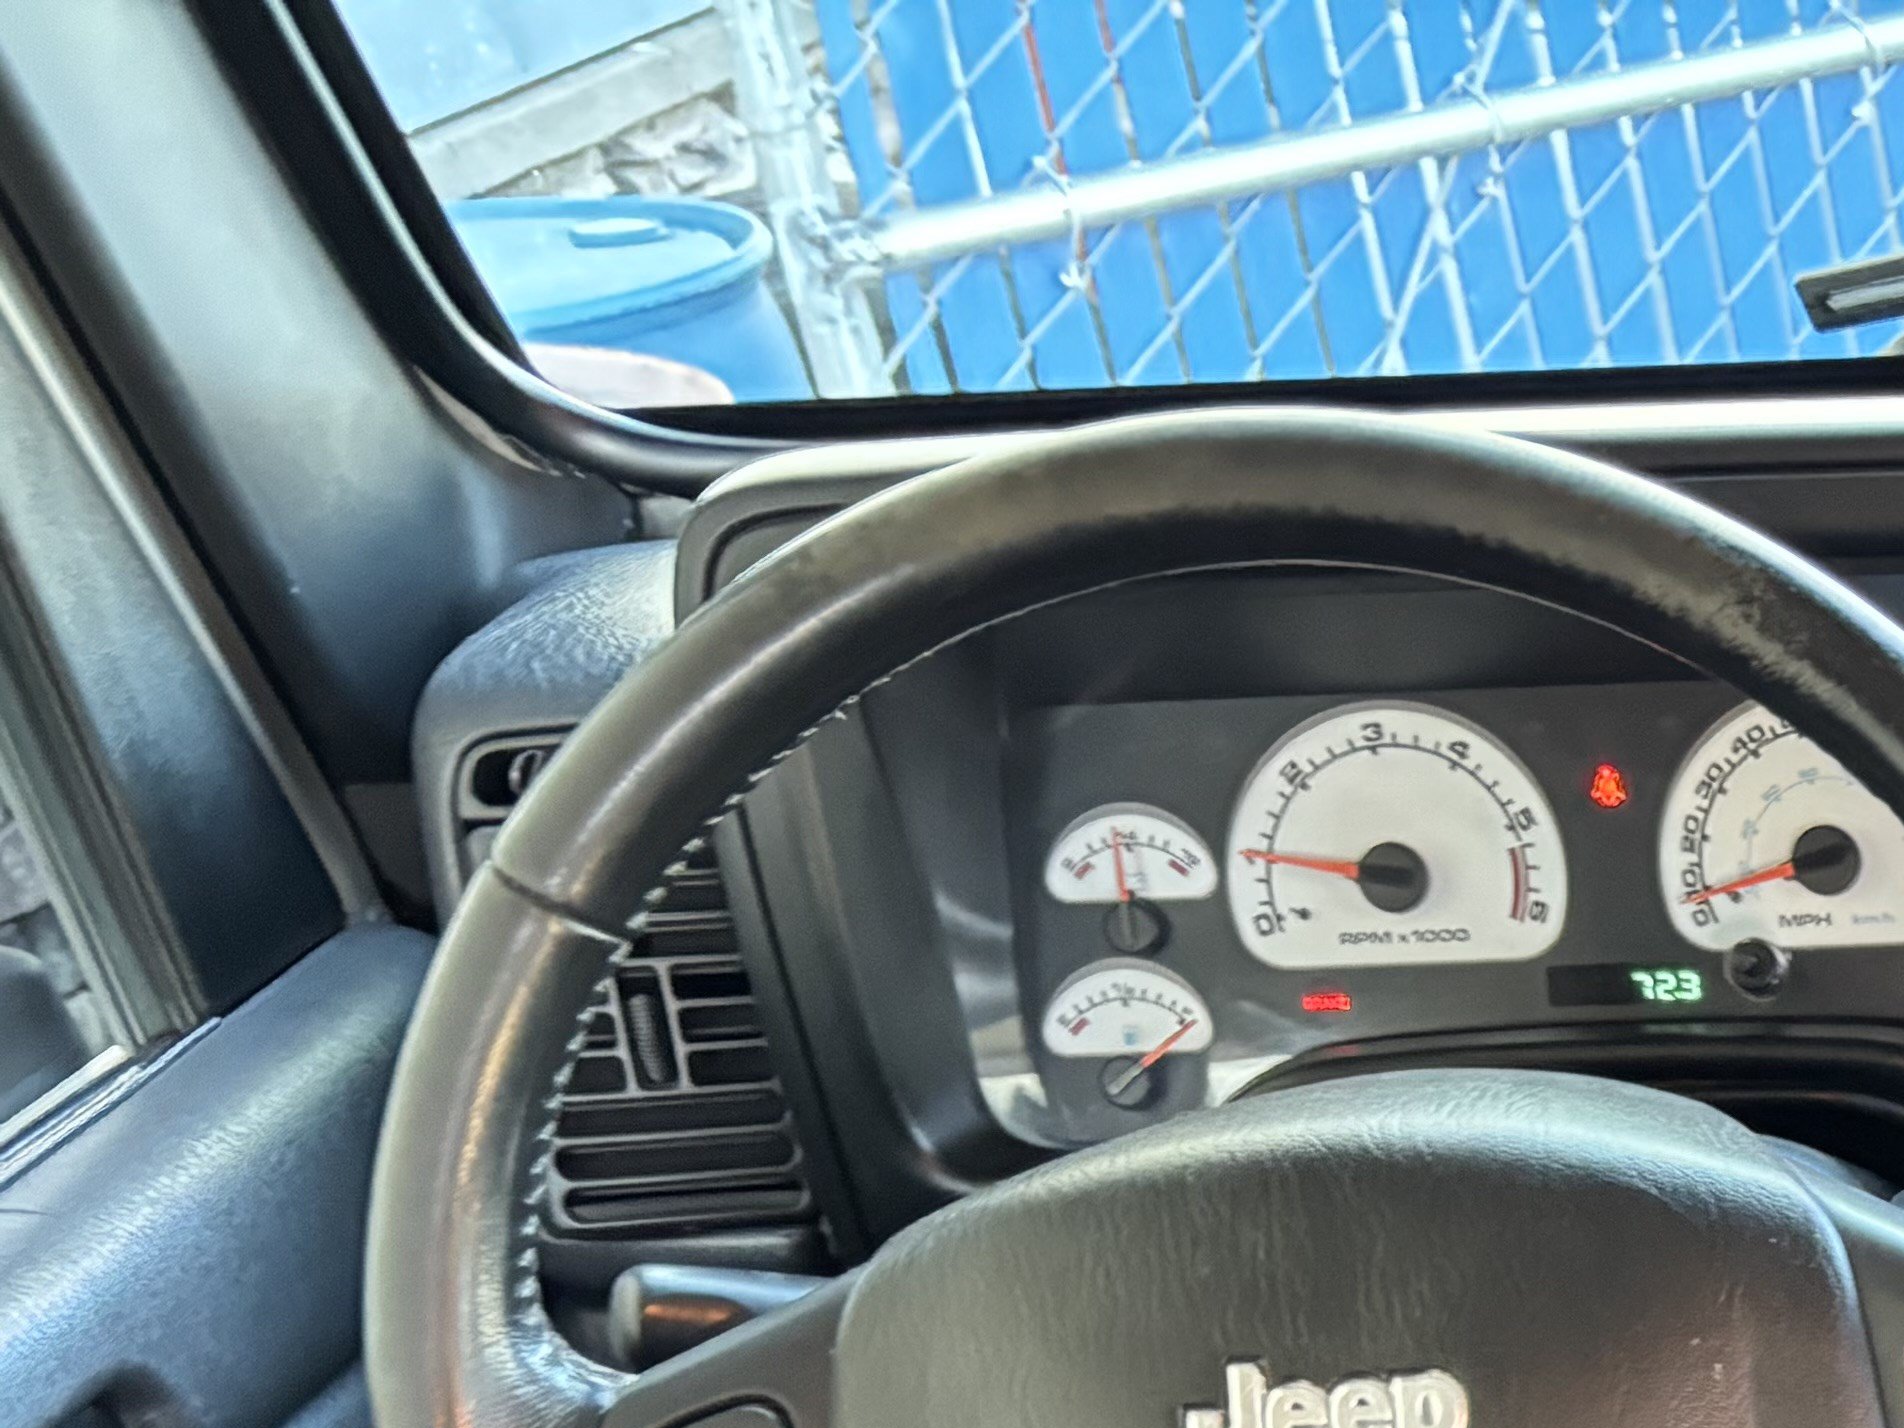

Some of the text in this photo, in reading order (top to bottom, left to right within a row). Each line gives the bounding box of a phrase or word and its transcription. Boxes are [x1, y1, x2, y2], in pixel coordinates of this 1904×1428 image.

[1360, 721, 1384, 743] 3
[1447, 739, 1470, 761] 4
[1694, 762, 1724, 800] 30
[1513, 806, 1540, 833] 5
[1680, 814, 1700, 854] 20
[1251, 912, 1276, 938] 0
[1778, 912, 1834, 929] MPH
[1629, 969, 1703, 1002] 723
